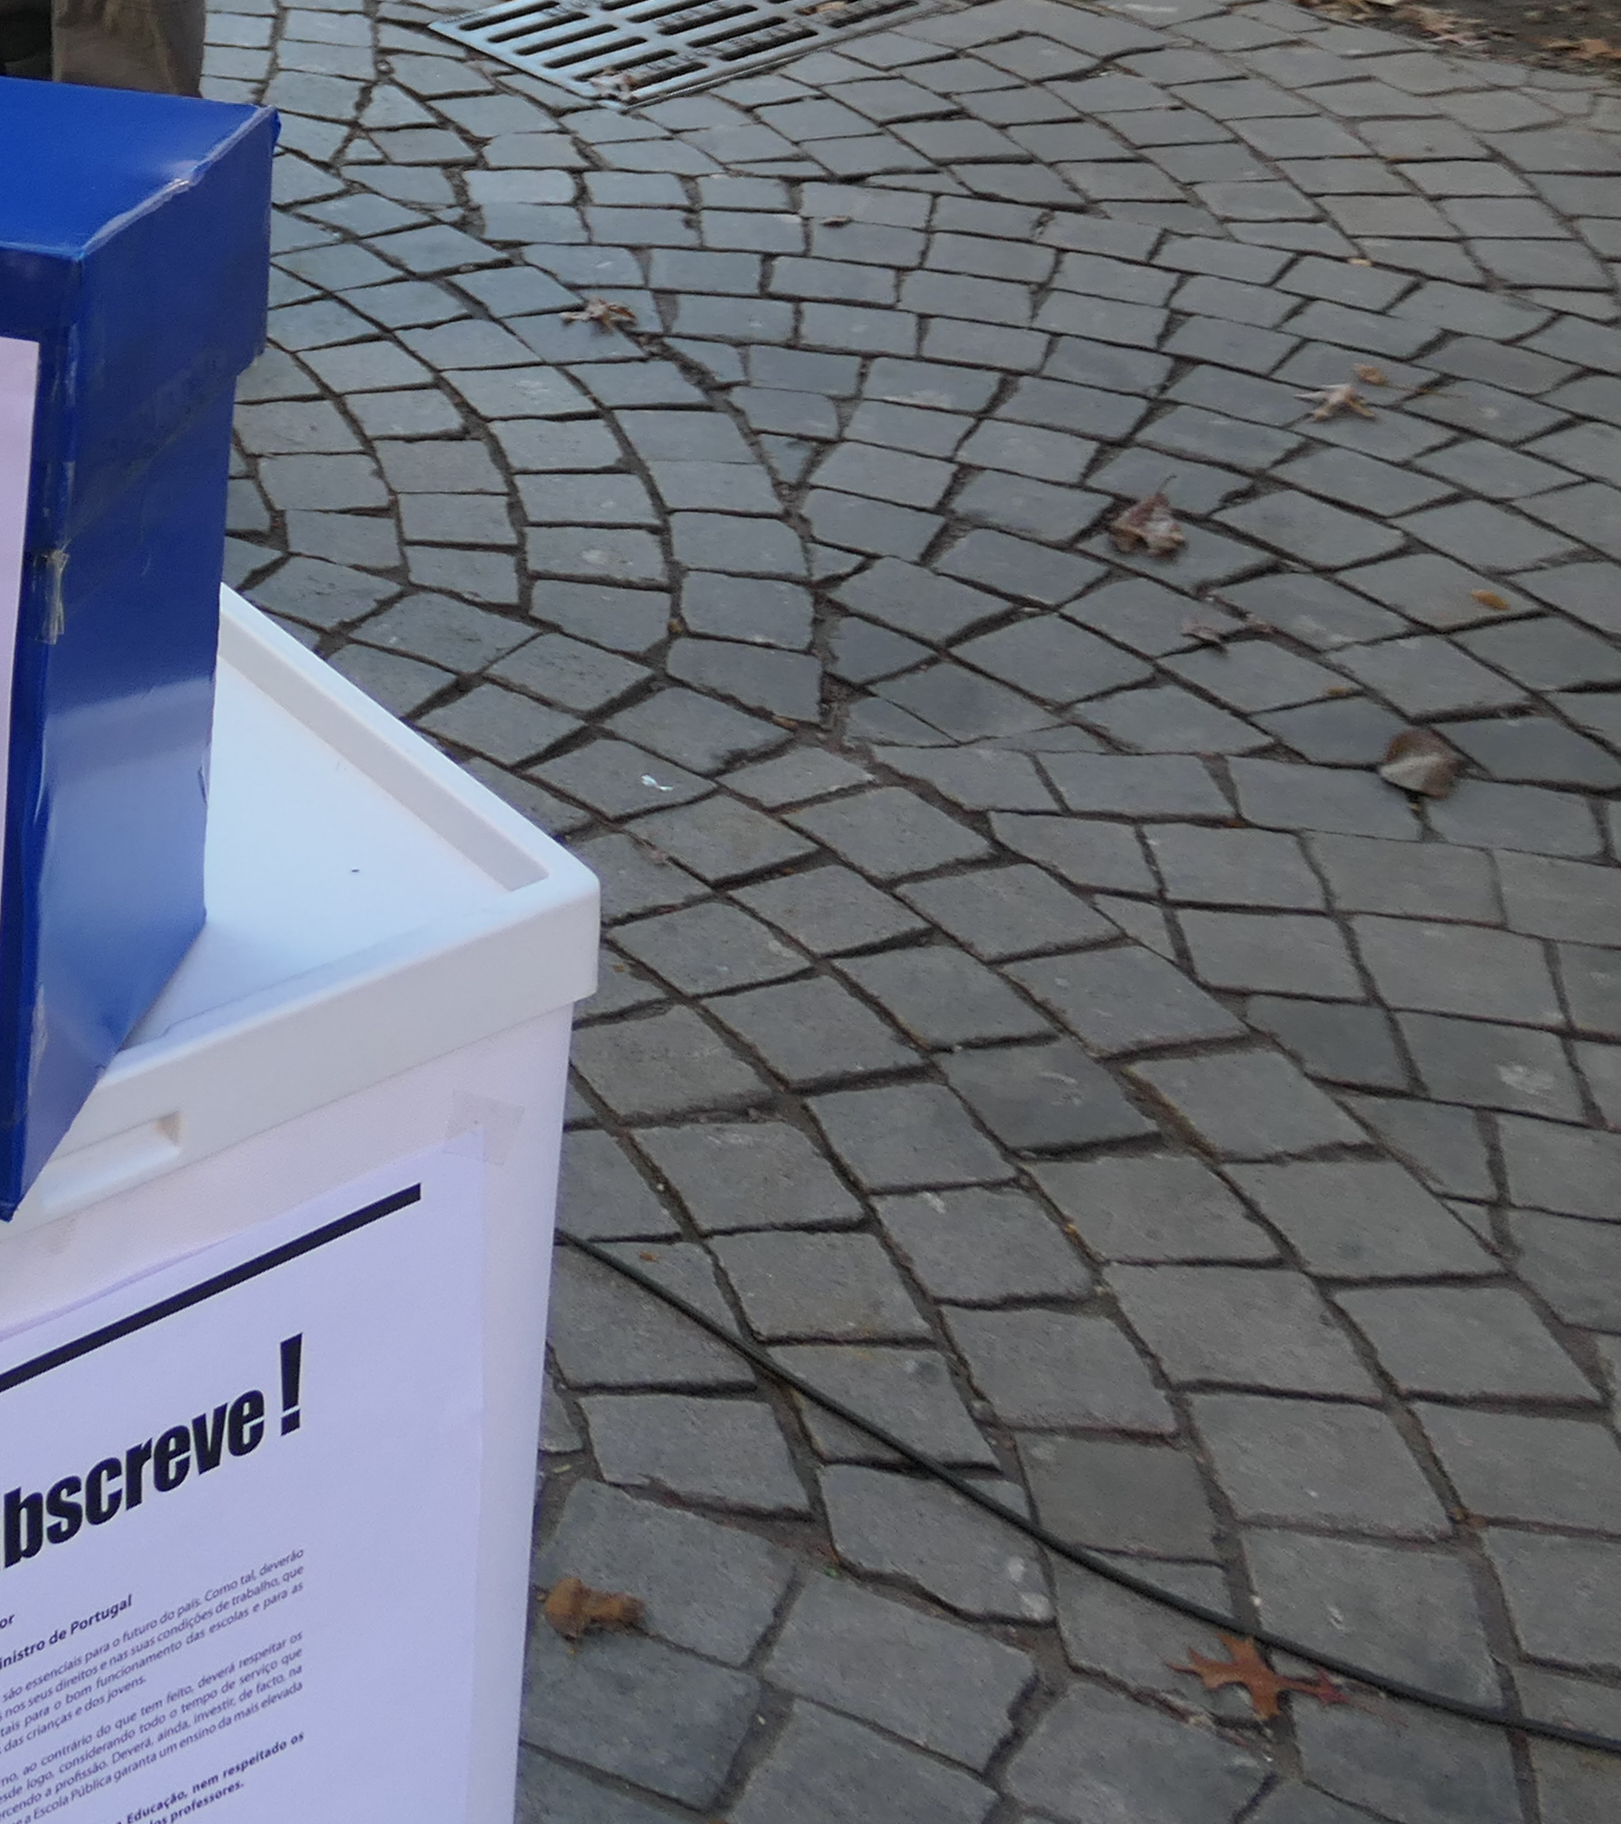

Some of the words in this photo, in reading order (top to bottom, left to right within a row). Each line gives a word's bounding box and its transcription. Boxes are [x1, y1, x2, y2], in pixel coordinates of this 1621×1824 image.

[2, 1685, 24, 1704] são
[84, 1641, 111, 1666] para
[122, 1618, 159, 1644] futuro
[204, 1579, 239, 1603] Como
[258, 1548, 305, 1577] deverão
[4, 1700, 26, 1719] nos
[27, 1686, 54, 1710] seus
[108, 1649, 129, 1668] nas
[130, 1635, 156, 1657] suas
[281, 1565, 305, 1584] que
[23, 1705, 50, 1730] para
[65, 1684, 93, 1706] bom
[185, 1627, 206, 1646] das
[208, 1607, 250, 1635] escolas
[262, 1589, 289, 1611] para
[47, 1628, 68, 1649] de
[70, 1592, 133, 1637] Portugal
[3, 1734, 25, 1753] das
[83, 1694, 106, 1713] dos
[114, 1711, 138, 1732] que
[140, 1699, 164, 1718] tem
[197, 1661, 236, 1690] deverá
[138, 1713, 167, 1735] todo
[180, 1688, 218, 1715] tempo
[238, 1659, 279, 1687] serviço
[280, 1647, 303, 1667] que
[33, 1794, 69, 1821] Escola
[70, 1773, 113, 1802] Pública
[113, 1751, 158, 1784] garanta
[179, 1723, 218, 1750] ensino
[233, 1701, 261, 1723] mais
[260, 1681, 304, 1710] elevada
[191, 1773, 220, 1795] nem
